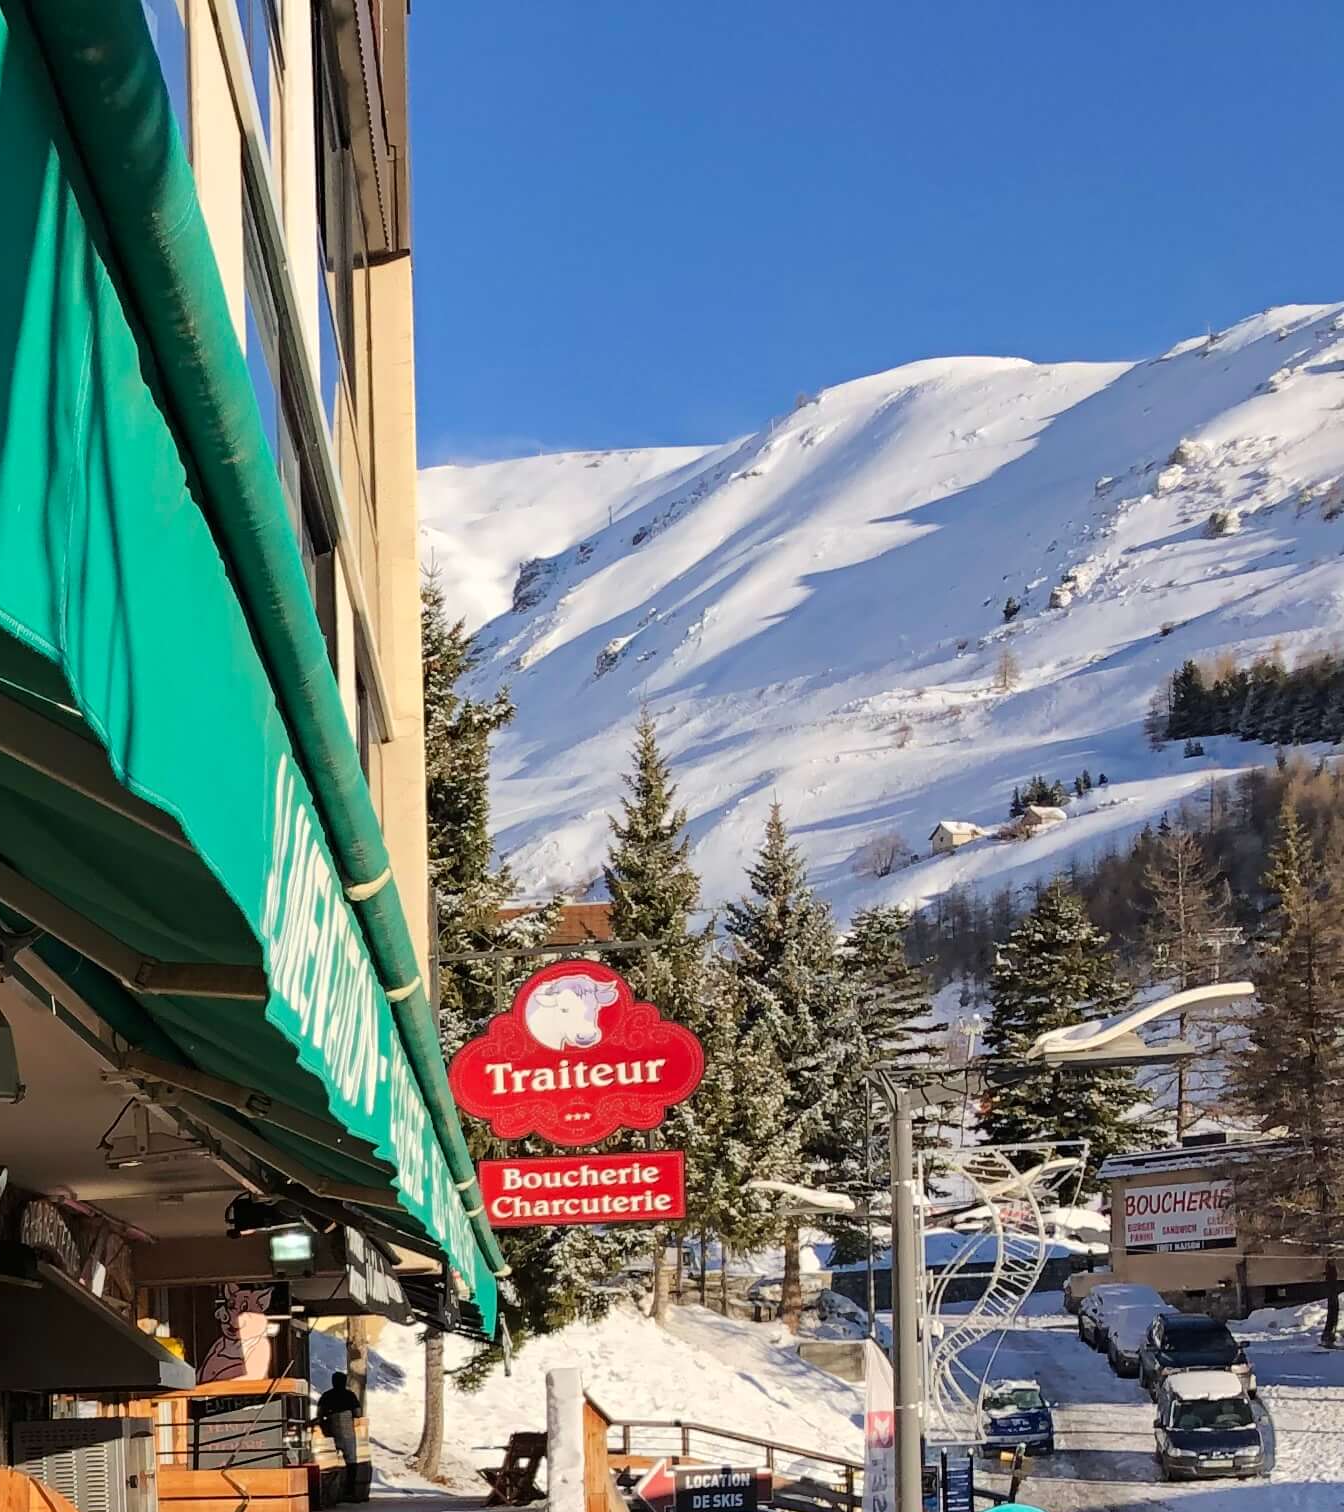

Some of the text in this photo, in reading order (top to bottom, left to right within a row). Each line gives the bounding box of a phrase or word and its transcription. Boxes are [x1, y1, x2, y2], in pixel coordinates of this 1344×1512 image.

[485, 1059, 666, 1095] Traiteur
[502, 1163, 659, 1191] Boucherie
[491, 1190, 672, 1218] Charcuterie
[1125, 1189, 1230, 1217] BOUCHERIE
[685, 1473, 751, 1490] LOCATION
[693, 1493, 744, 1509] DE SKIS
